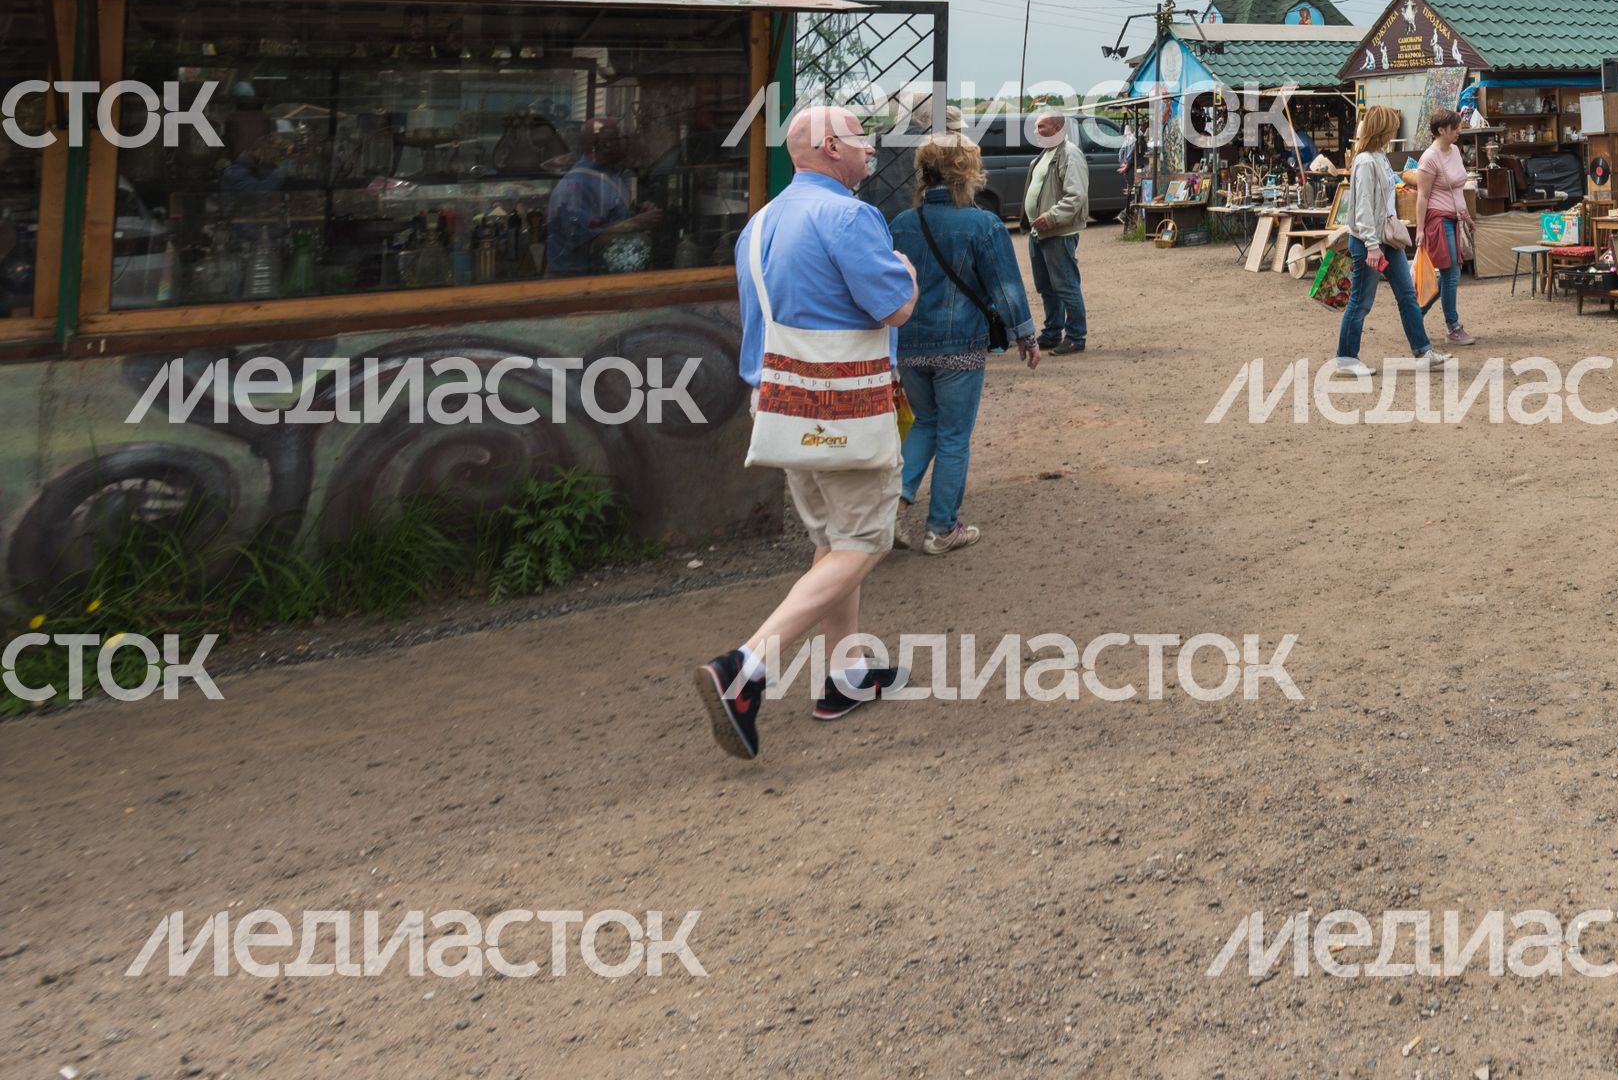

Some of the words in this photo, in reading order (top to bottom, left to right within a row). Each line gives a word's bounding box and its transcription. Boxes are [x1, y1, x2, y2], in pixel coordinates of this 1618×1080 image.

[1372, 10, 1399, 47] ПОКУПКА
[1422, 7, 1450, 40] ПРОДАЖА
[773, 372, 832, 388] OCAPU
